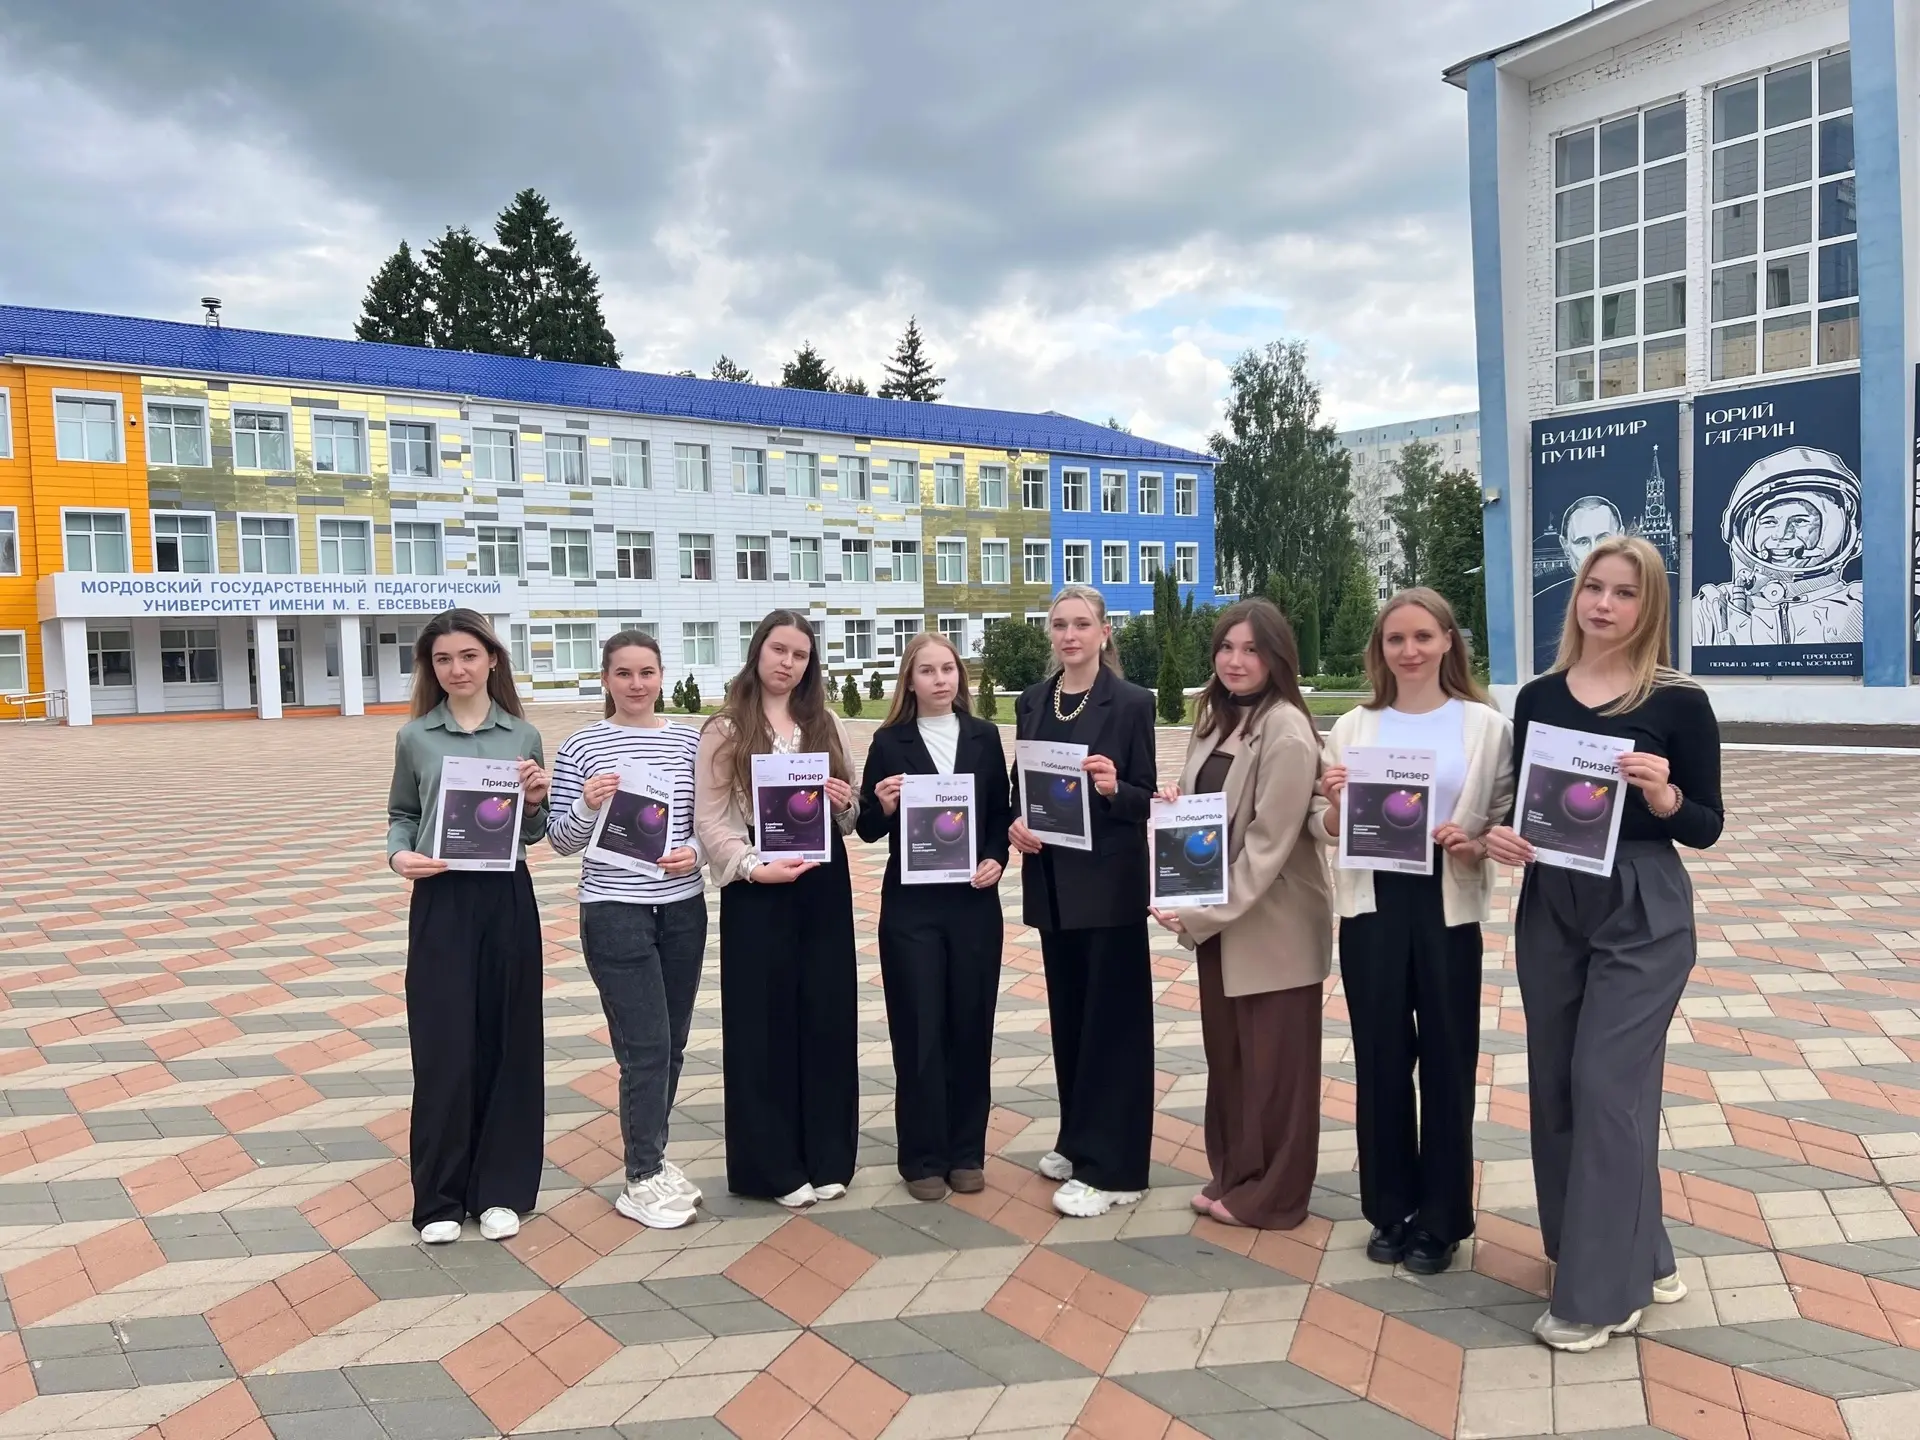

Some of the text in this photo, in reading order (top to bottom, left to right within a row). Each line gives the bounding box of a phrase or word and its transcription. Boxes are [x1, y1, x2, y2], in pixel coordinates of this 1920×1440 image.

[1705, 401, 1774, 426] ЮРИЙ
[1541, 420, 1648, 446] ВЛАДИМИР
[1705, 421, 1795, 446] ГАГАРИН
[1541, 444, 1605, 464] ПУТИН
[81, 578, 501, 596] МОРДОВСКИЙ ГОСУДАРСТВЕННЫЙ ПЕДАГОГИЧЕСКИЙ
[143, 598, 457, 612] УНИВЕРСИТЕТ ИМЕНИ М. Е. ЕВСЕВЬЕВА
[1571, 756, 1619, 775] Призер
[788, 773, 824, 782] Призер
[1386, 769, 1430, 781] Призер
[481, 778, 520, 789] Призер
[645, 784, 670, 799] Призер
[935, 794, 969, 803] Призер
[1175, 813, 1223, 822] Победитель
